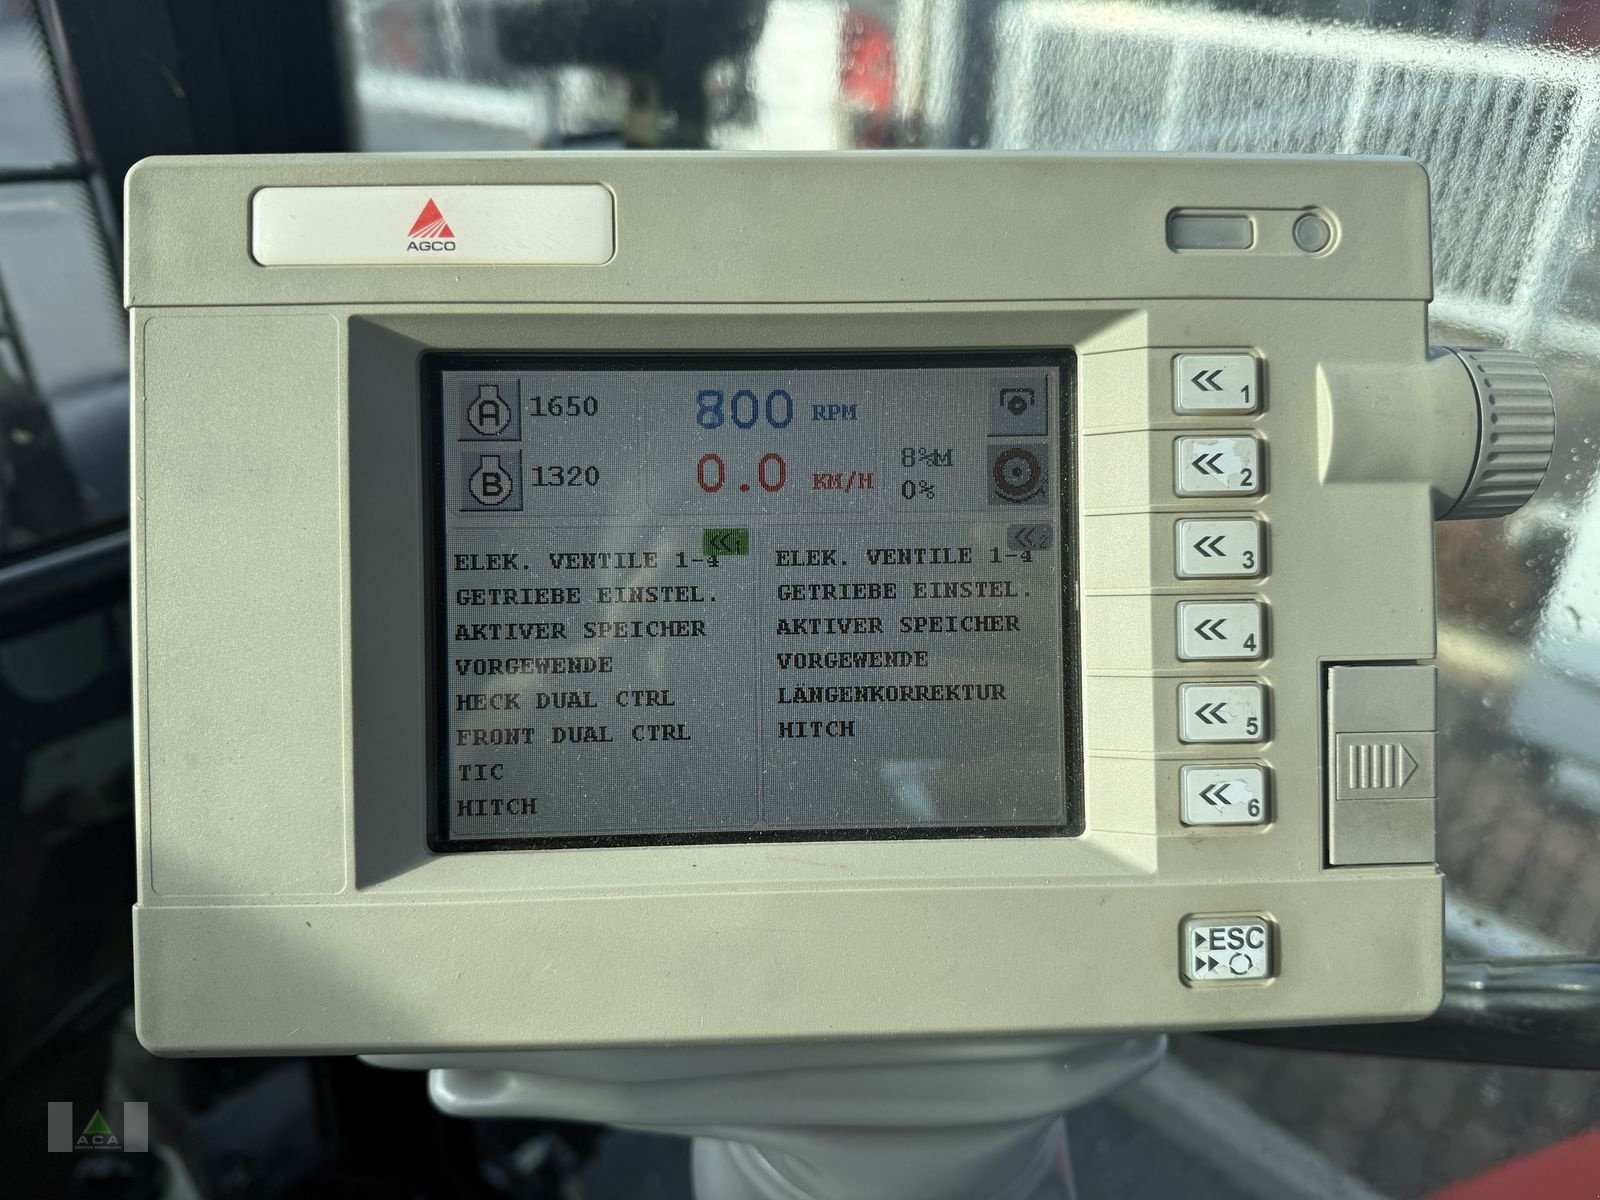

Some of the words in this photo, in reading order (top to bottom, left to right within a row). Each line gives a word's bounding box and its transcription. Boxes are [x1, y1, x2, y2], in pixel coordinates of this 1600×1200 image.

[406, 241, 456, 252] AGCO
[1240, 384, 1250, 403] 1
[478, 400, 500, 426] A
[529, 395, 599, 417] 1650
[695, 389, 794, 429] 800
[811, 403, 859, 421] RPM
[531, 466, 600, 487] 1320
[696, 452, 787, 493] 0.0
[811, 470, 875, 493] KM/H
[1240, 468, 1253, 487] 2
[482, 472, 504, 497] B
[901, 480, 935, 500] 0%
[454, 553, 530, 571] ELEK.
[549, 551, 658, 569] VENTILE
[675, 551, 720, 568] 1-4
[775, 550, 847, 567] ELEK.
[866, 547, 972, 565] VENTILE
[989, 547, 1033, 563] 1-4
[1241, 550, 1255, 569] 3
[456, 587, 581, 605] GETRIEBE
[597, 585, 717, 604] EINSTEL.
[777, 582, 897, 600] GETRIEBE
[913, 581, 1031, 599] EINSTEL.
[455, 622, 567, 641] AKTIVER
[583, 620, 707, 639] SPEICHER
[776, 617, 884, 635] AKTIVER
[900, 615, 1021, 633] SPEICHER
[1243, 633, 1257, 652] 4
[455, 656, 613, 676] VORGEWENDE
[776, 650, 928, 669] VORGEWENDE
[456, 693, 522, 711] HECK
[535, 691, 598, 709] DUAL
[616, 689, 675, 707] CTRL
[778, 683, 1007, 704] LÄNGENKORREKTUR
[456, 727, 535, 746] FRONT
[551, 726, 613, 744] DUAL
[631, 724, 692, 742] CTRL
[778, 720, 856, 738] HITCH
[1245, 716, 1259, 736] 5
[458, 763, 504, 782] TIC
[456, 797, 538, 817] HITCH
[1247, 798, 1261, 818] 6
[1208, 926, 1265, 951] ESC
